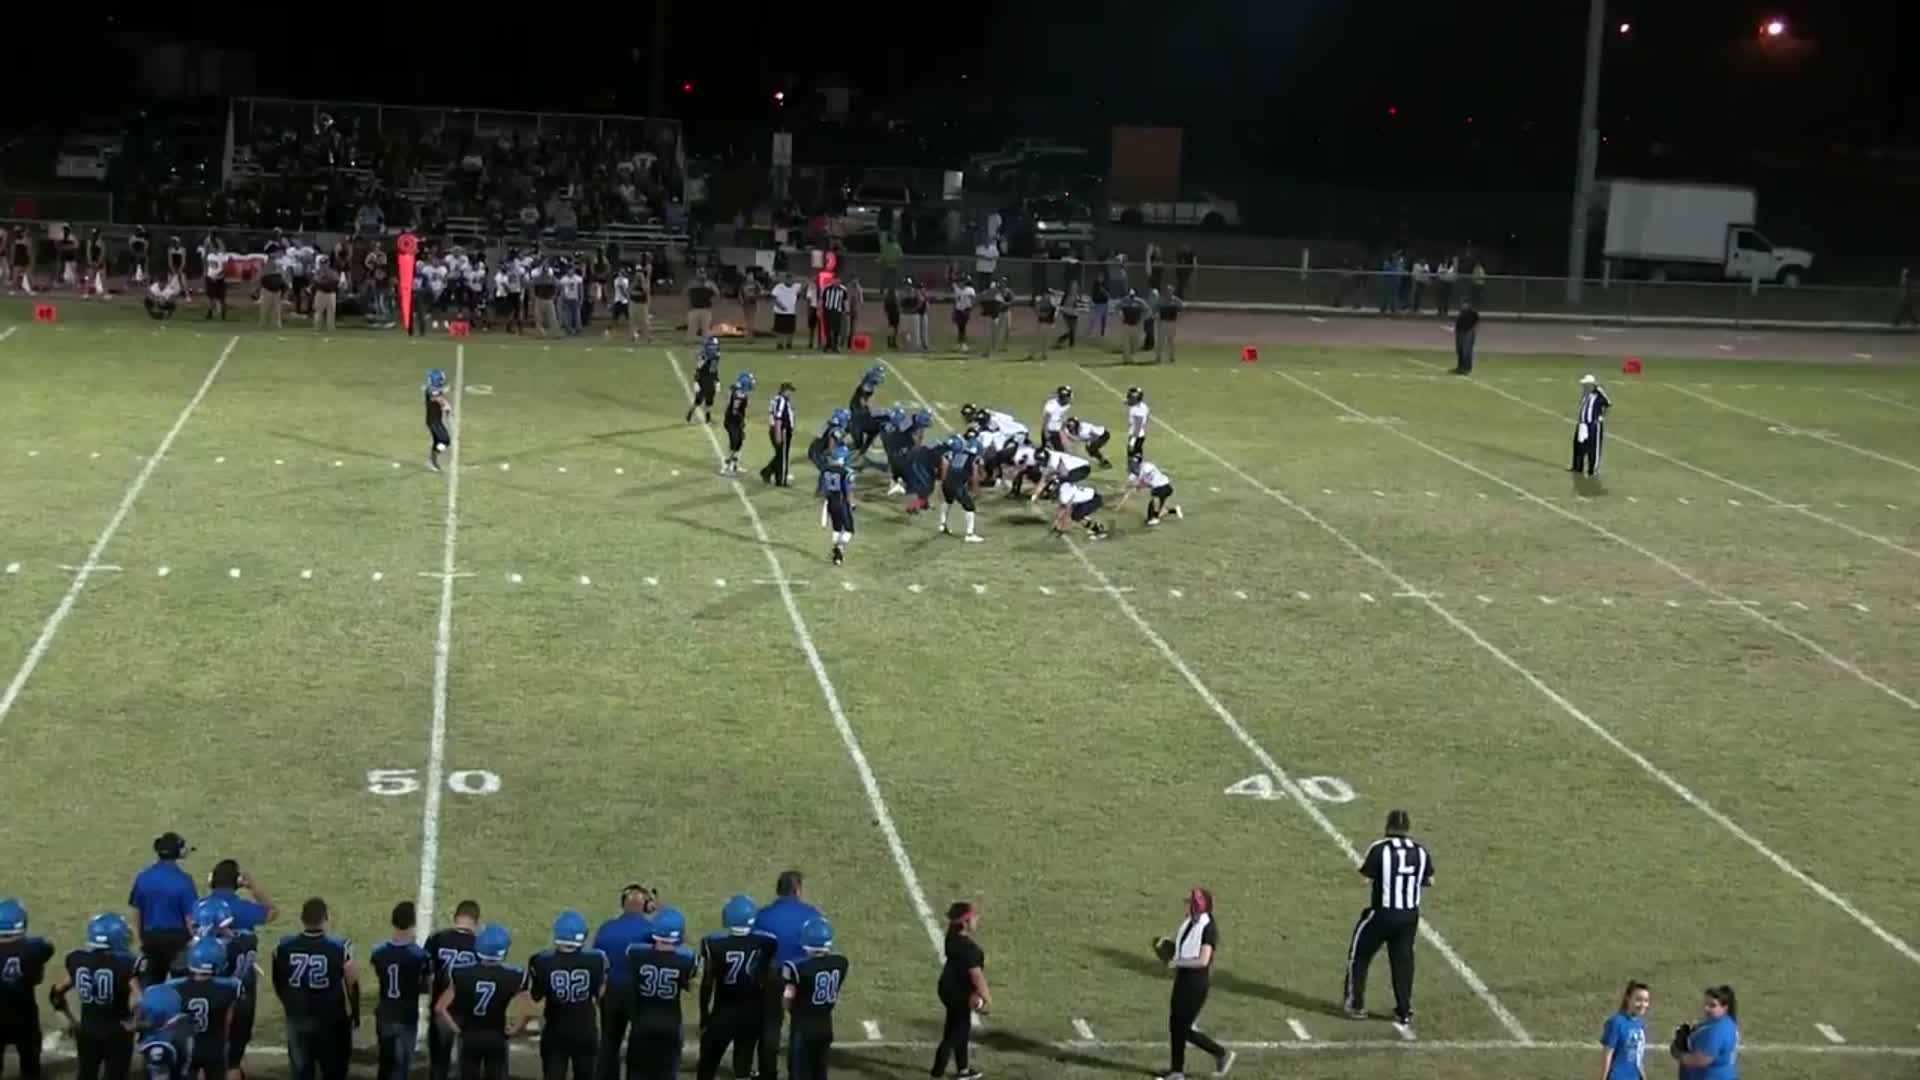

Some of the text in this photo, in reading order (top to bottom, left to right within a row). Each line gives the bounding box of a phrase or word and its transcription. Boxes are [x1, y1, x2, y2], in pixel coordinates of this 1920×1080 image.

[367, 769, 502, 796] 50
[1224, 775, 1356, 803] 40
[1397, 849, 1415, 874] L
[75, 967, 113, 1004] 60
[289, 954, 330, 988] 72
[387, 963, 400, 999] 1
[550, 969, 591, 1002] 82
[638, 966, 680, 999] 35
[187, 998, 209, 1032] 3
[473, 981, 496, 1016] 7
